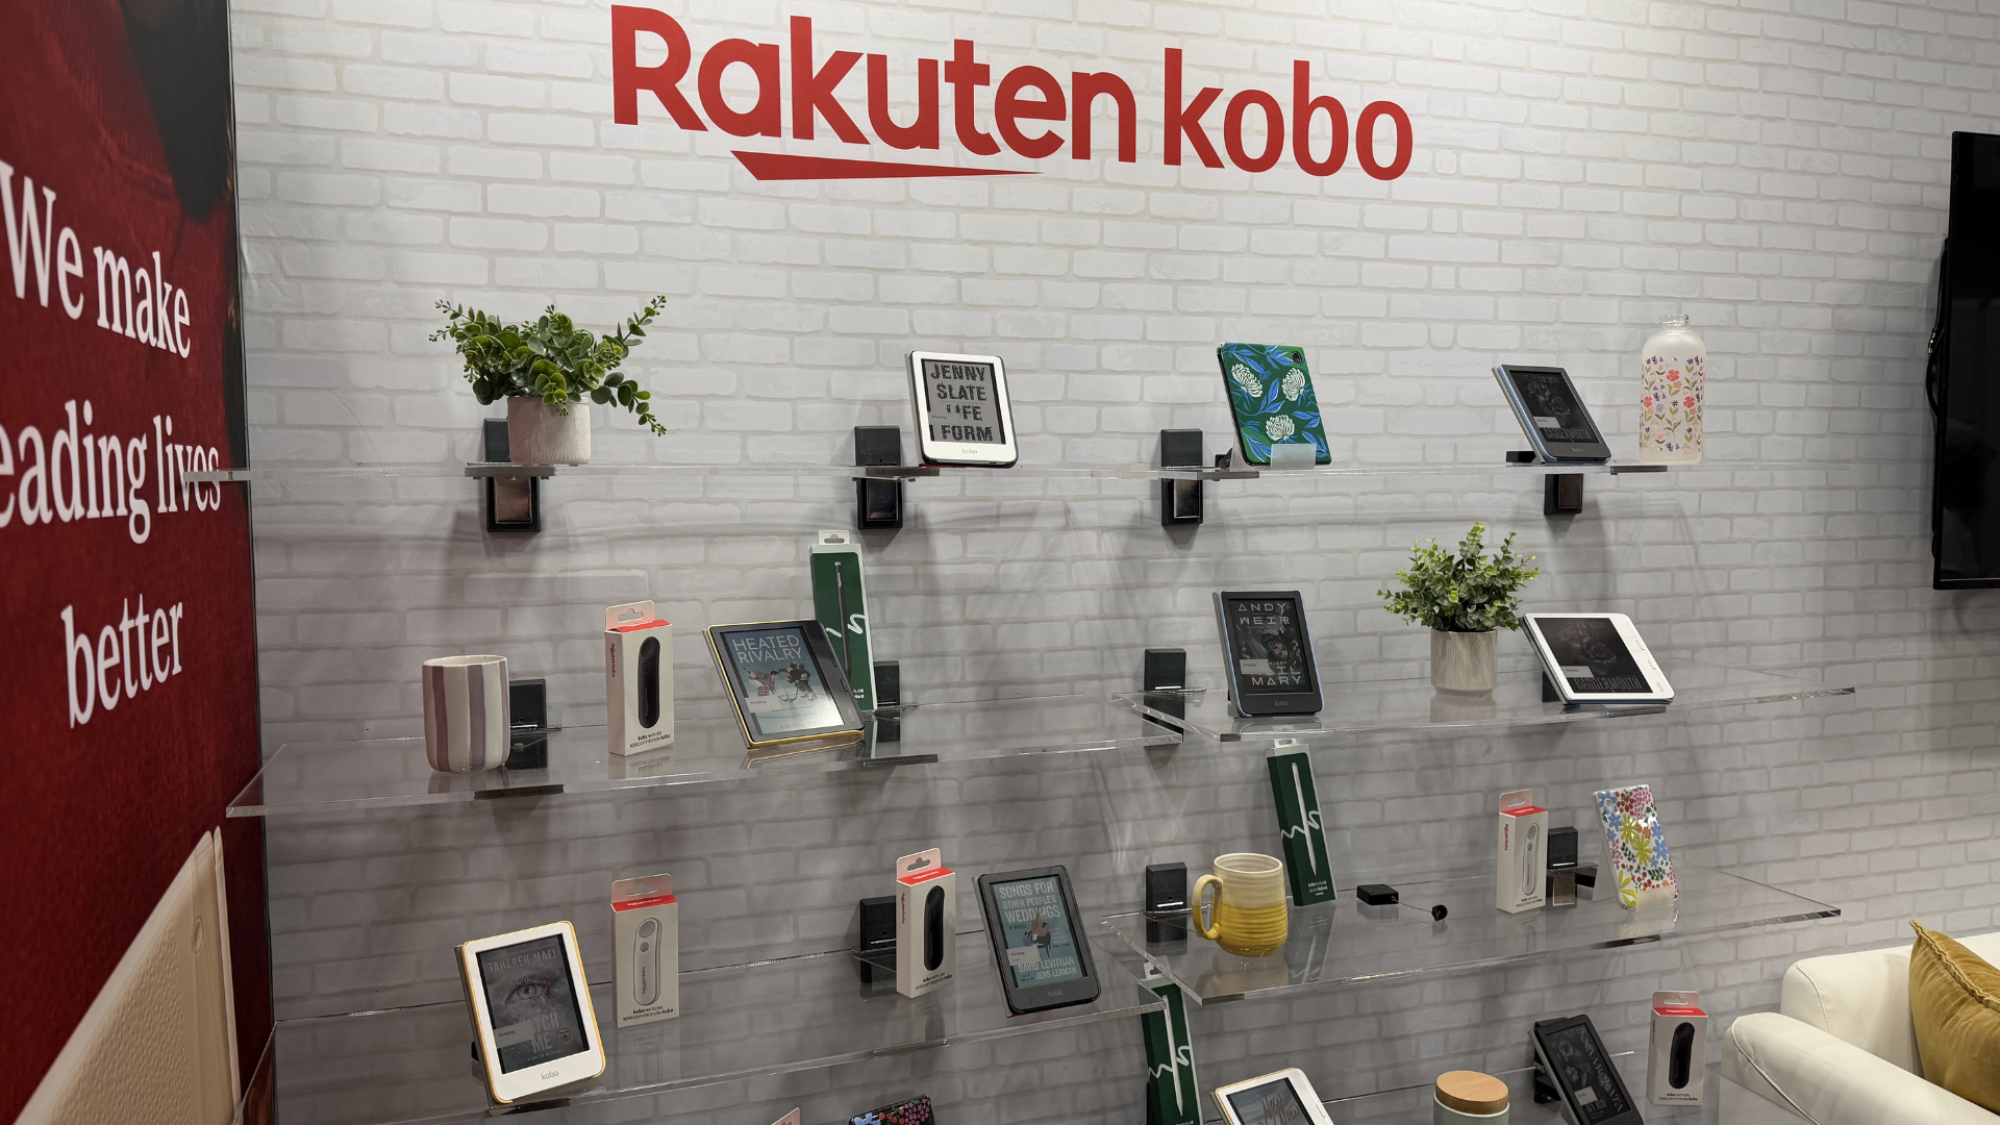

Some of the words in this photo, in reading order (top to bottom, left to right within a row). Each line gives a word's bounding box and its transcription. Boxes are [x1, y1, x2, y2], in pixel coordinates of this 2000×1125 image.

[611, 5, 1137, 164] Rakuten
[1164, 48, 1413, 181] kobo
[0, 160, 84, 320] We
[93, 246, 191, 359] make
[930, 363, 985, 381] JENNY
[936, 382, 987, 401] SLATE
[941, 424, 993, 442] FORM
[153, 414, 221, 513] lives
[1238, 602, 1287, 613] ANDY
[1239, 616, 1291, 625] WEIR
[732, 634, 800, 652] HEATED
[61, 594, 183, 728] better
[736, 647, 802, 664] RIVALRY
[1276, 665, 1301, 675] IL
[1251, 675, 1301, 686] MARY
[999, 884, 1033, 899] SONGS
[1033, 881, 1055, 895] FOR
[1002, 898, 1025, 910] OTHER
[1004, 905, 1061, 924] WEDDINGS
[487, 954, 530, 974] TAHEREH
[533, 948, 557, 962] MAFI
[1018, 960, 1039, 973] DAVID
[1040, 956, 1075, 969] LEVITHAN
[1035, 970, 1052, 980] JENS
[531, 1032, 553, 1054] ME
[541, 1070, 559, 1081] kobo
